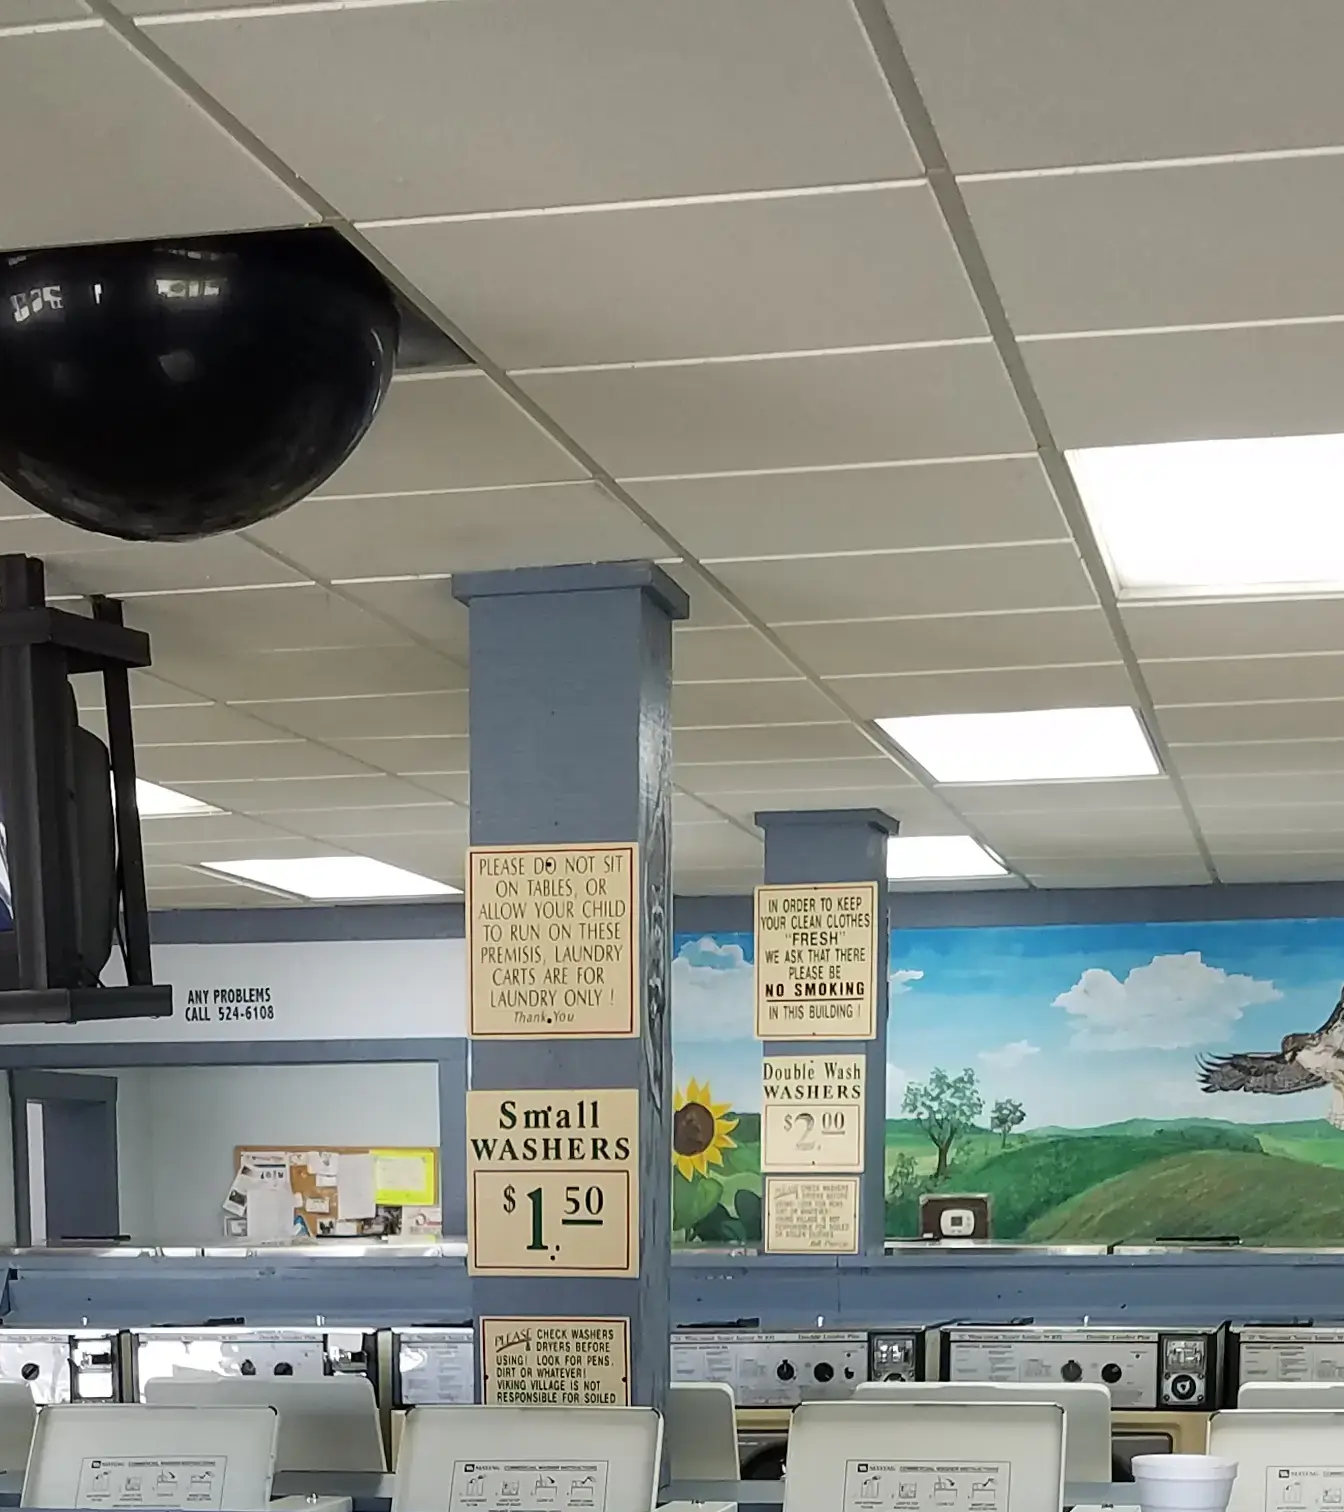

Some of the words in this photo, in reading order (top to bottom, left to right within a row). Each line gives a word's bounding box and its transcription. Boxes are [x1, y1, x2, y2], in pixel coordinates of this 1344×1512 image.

[480, 858, 524, 876] PLEASE
[534, 857, 556, 873] DO
[565, 856, 595, 873] NOT
[604, 855, 623, 873] SIT
[496, 881, 518, 897] ON
[586, 878, 606, 895] OR
[479, 903, 527, 920] ALLOW
[535, 902, 574, 918] YOUR
[583, 900, 625, 918] CHILD
[769, 900, 777, 913] IN
[783, 899, 815, 912] ORDER
[821, 898, 832, 911] TO
[838, 897, 862, 910] KEEP
[761, 917, 786, 930] YOUR
[792, 915, 821, 929] CLEAN
[827, 913, 870, 928] CLOTHES
[484, 924, 502, 941] TO
[511, 925, 540, 941] RUN
[549, 924, 571, 941] ON
[579, 923, 620, 939] THESE
[556, 945, 623, 963] LAUNDRY
[765, 950, 779, 964] WE
[785, 950, 803, 963] ASK
[809, 949, 830, 962] THAT
[836, 948, 865, 961] THERE
[493, 968, 535, 986] CARTS
[543, 968, 567, 984] ARE
[577, 967, 604, 984] FOR
[789, 966, 823, 980] PLEASE
[829, 966, 840, 978] BE
[188, 990, 210, 1005] ANY
[214, 988, 271, 1004] PROBLEMS
[766, 984, 784, 997] NO
[795, 982, 864, 996] SMOKING
[491, 990, 556, 1007] LAUNDRY
[565, 990, 602, 1006] ONLY
[185, 1007, 210, 1021] CALL
[218, 1006, 274, 1020] 524-6108
[514, 1012, 545, 1023] Thank
[555, 1012, 574, 1022] You
[769, 1006, 778, 1019] IN
[784, 1006, 804, 1019] THIS
[810, 1004, 853, 1018] BUILDING
[763, 1063, 815, 1080] Double
[824, 1062, 860, 1080] Wash
[763, 1085, 860, 1099] WASHERS
[500, 1100, 599, 1129] Small
[471, 1137, 629, 1160] WASHERS
[537, 1329, 568, 1339] CHECK
[572, 1329, 613, 1340] WASHERS
[536, 1341, 570, 1352] DRYERS
[576, 1342, 610, 1352] BEFORE
[537, 1355, 560, 1365] LOOK
[565, 1355, 583, 1365] FOR
[497, 1367, 517, 1378] DIRT
[520, 1368, 533, 1378] OR
[570, 1381, 579, 1391] IS
[583, 1381, 600, 1391] NOT
[497, 1392, 557, 1403] RESPONSIBLE
[563, 1392, 580, 1403] FOR
[584, 1393, 615, 1403] SOILED
